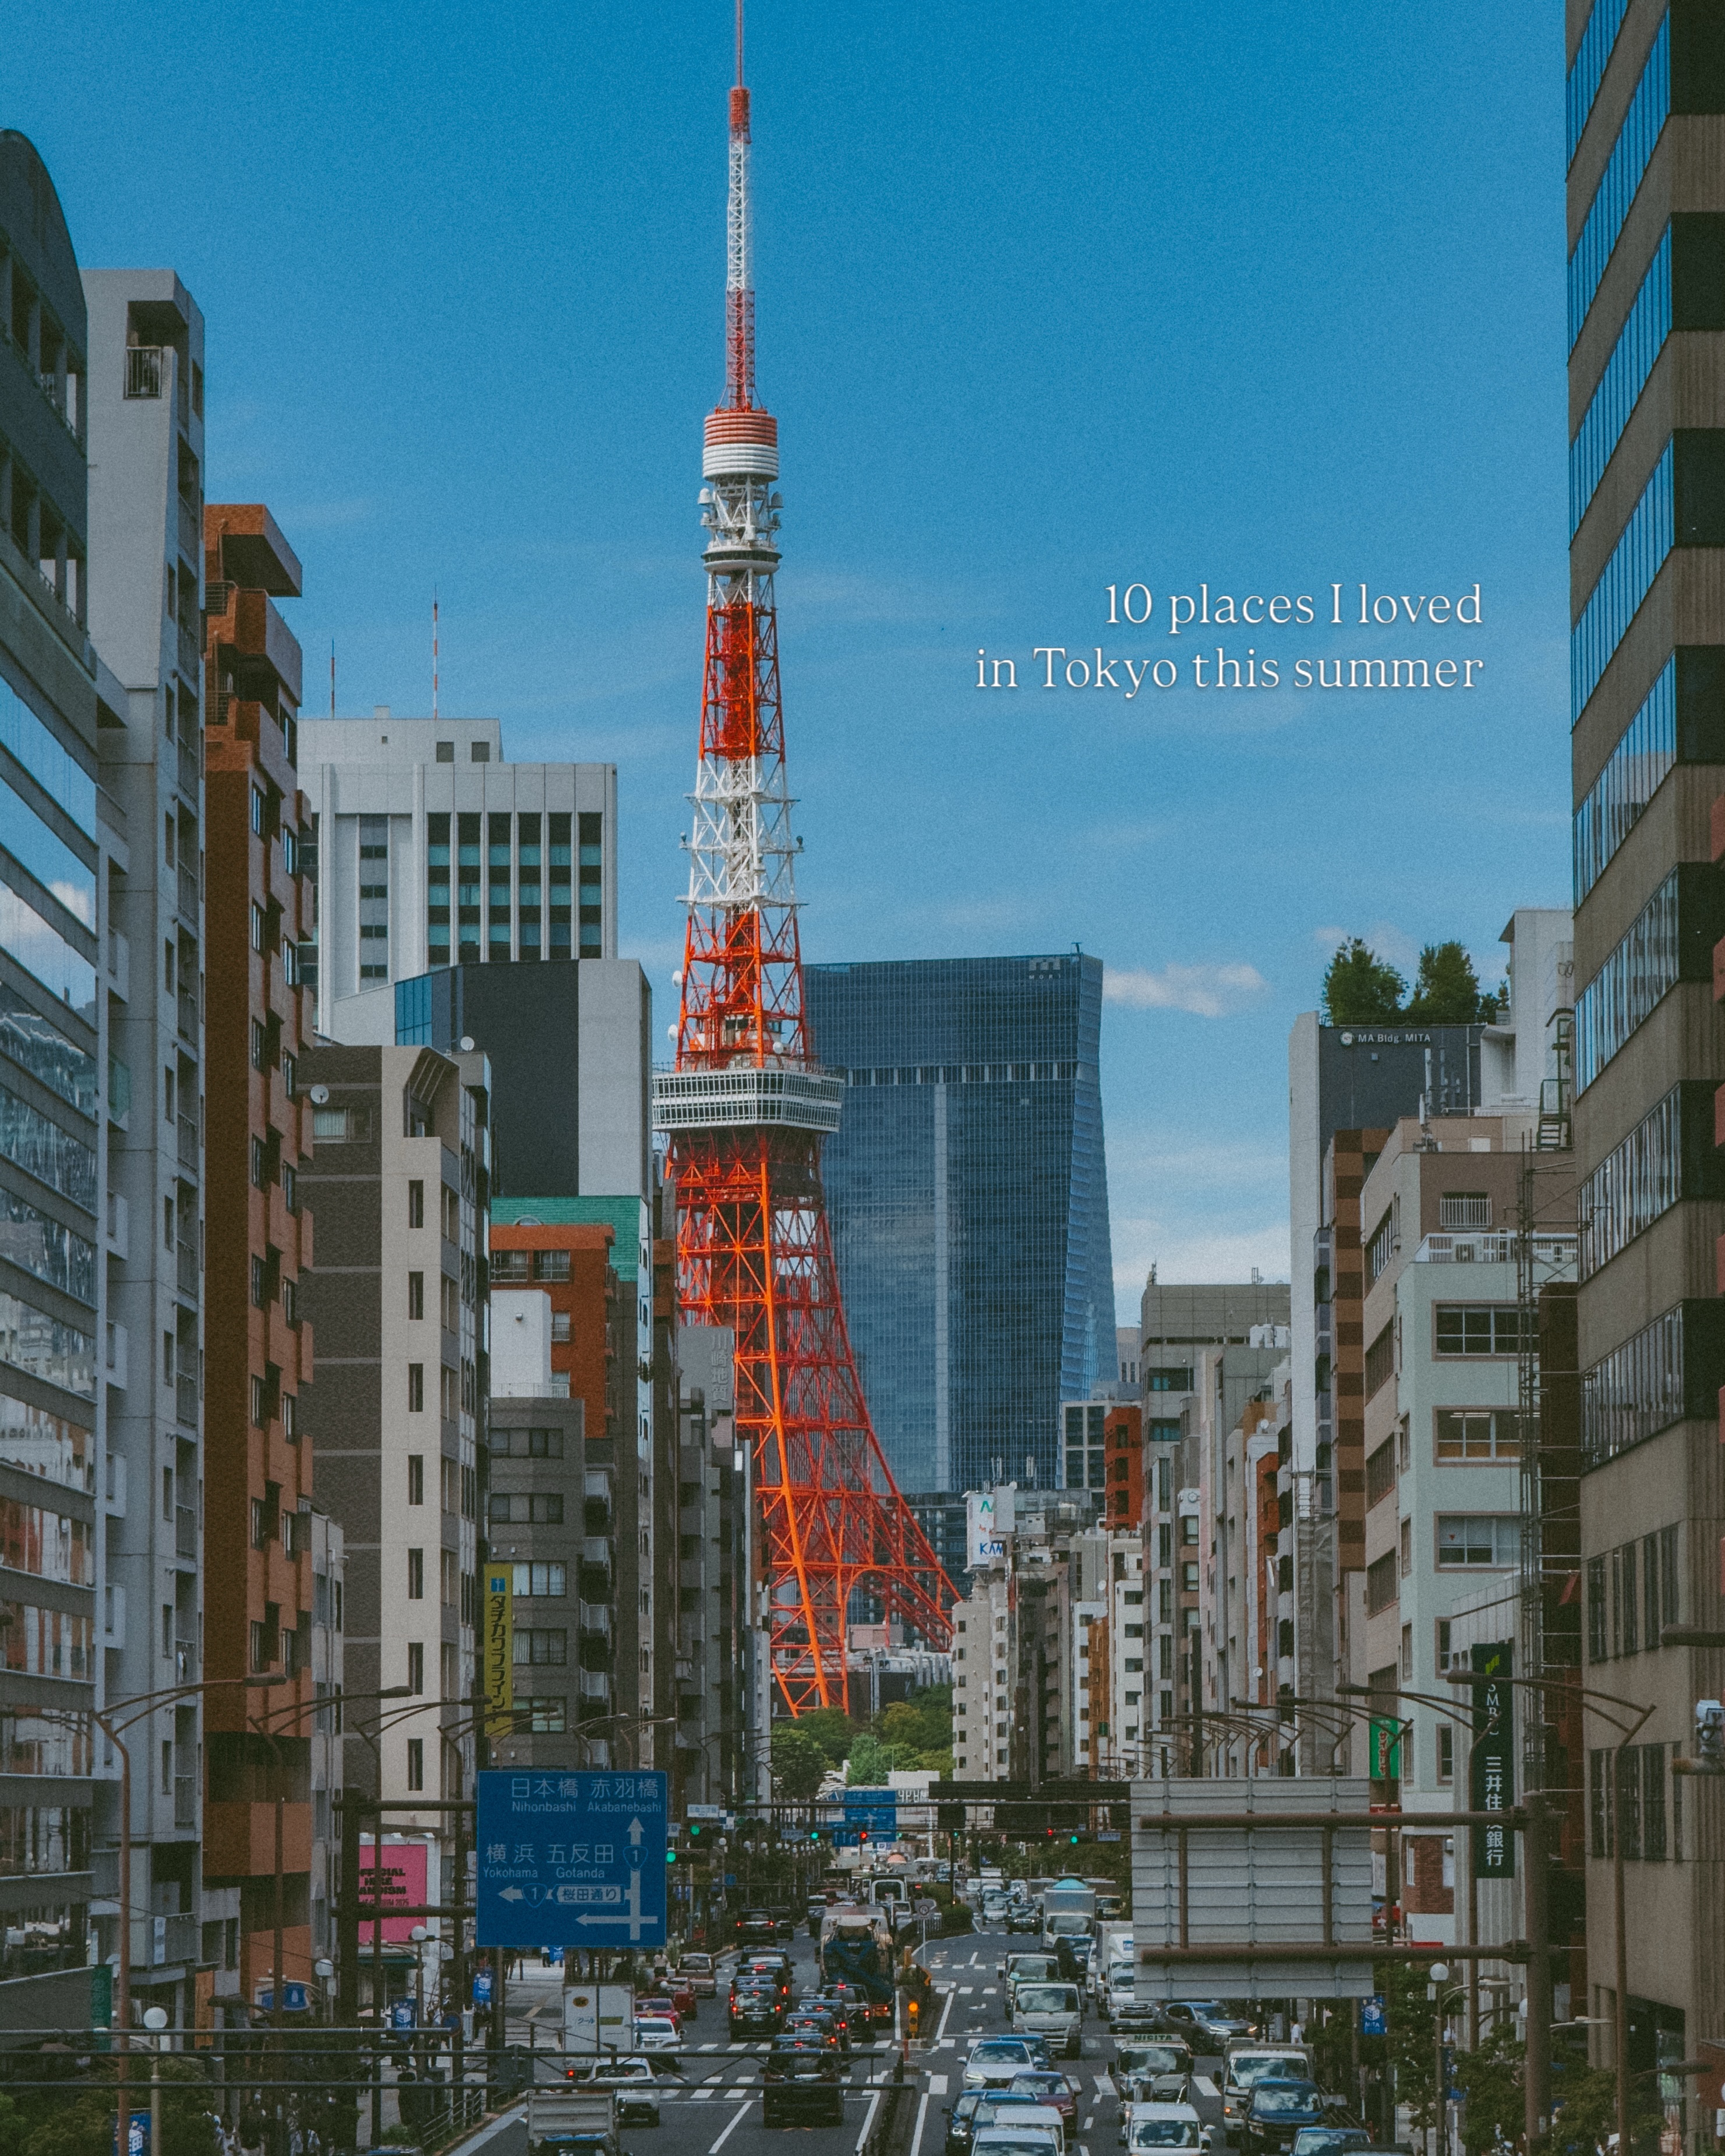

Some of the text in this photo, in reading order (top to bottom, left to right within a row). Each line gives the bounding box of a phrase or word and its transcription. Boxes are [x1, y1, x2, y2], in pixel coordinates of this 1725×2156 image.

[1358, 1034, 1374, 1042] MA
[1405, 1034, 1431, 1042] MITA
[710, 1333, 728, 1402] 川崎地質
[511, 1778, 659, 1798] 日本橋 赤羽橋
[512, 1801, 662, 1812] Nihonbashi Akabanebashi
[486, 1843, 614, 1864] 横浜 五反田
[632, 1850, 638, 1862] 1
[359, 1868, 406, 1876] FFCIAL
[483, 1867, 605, 1878] Yokohama Gotanda
[531, 1888, 537, 1900] 1
[561, 1888, 617, 1901] 桜田通り
